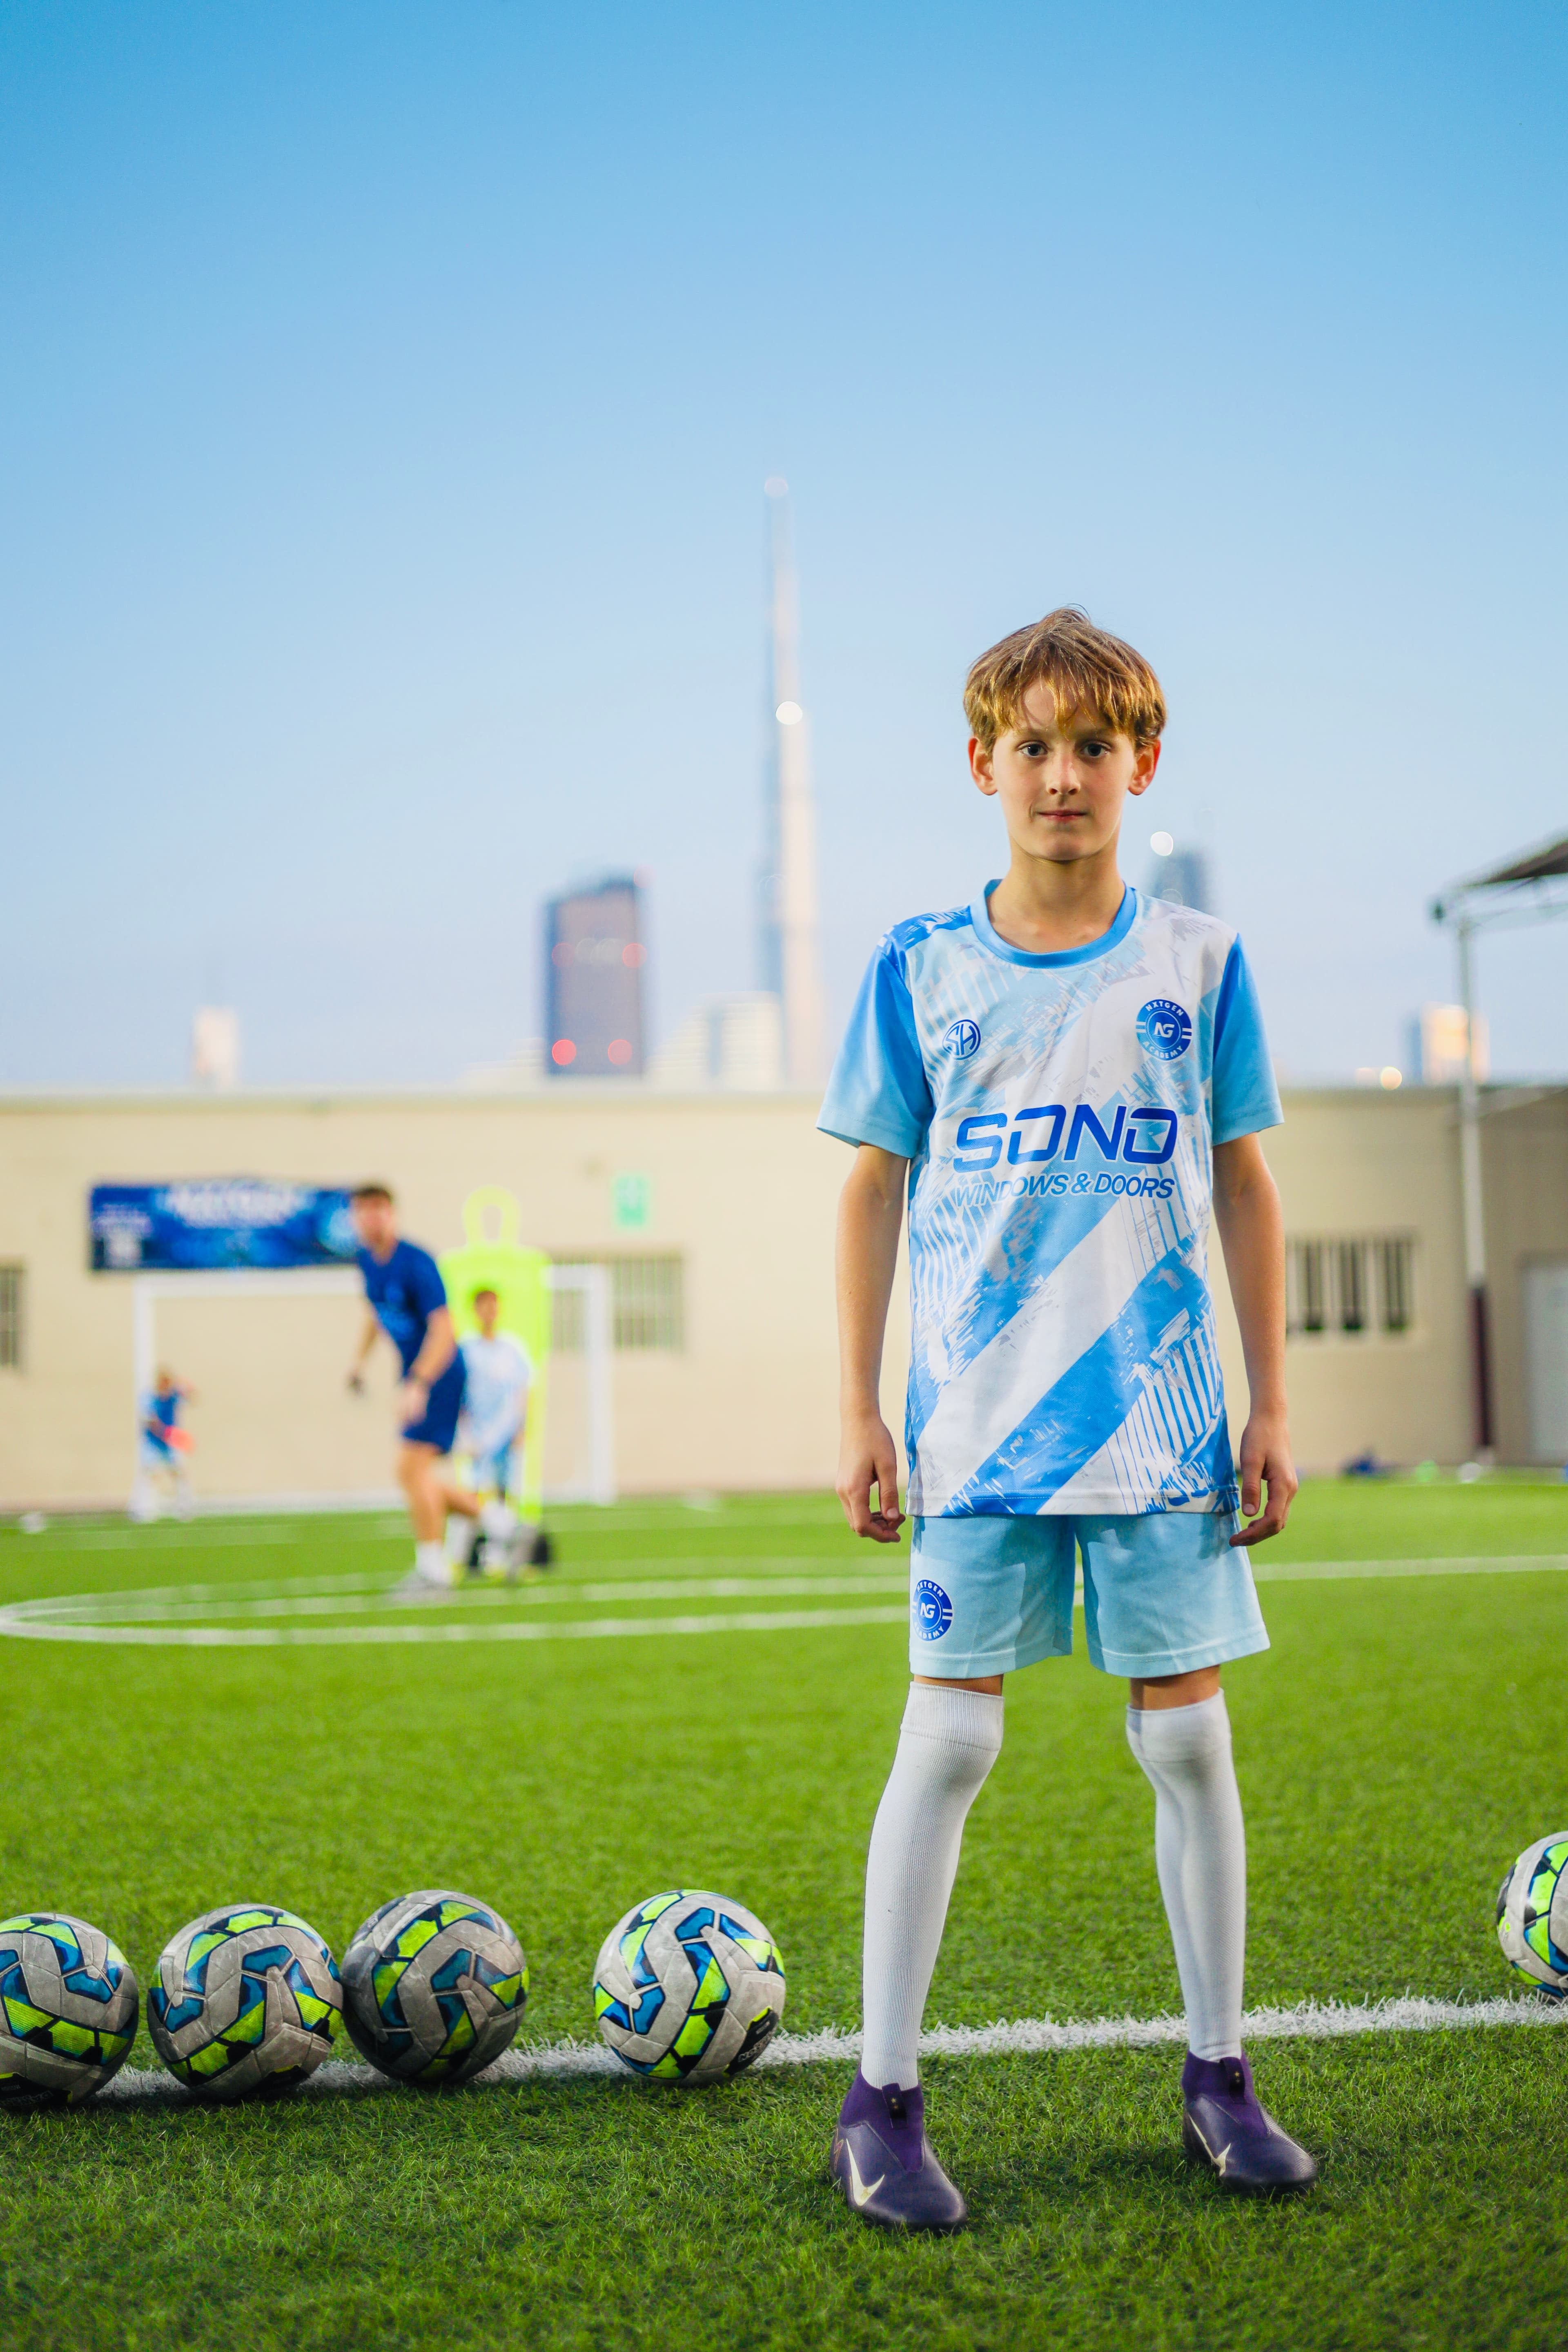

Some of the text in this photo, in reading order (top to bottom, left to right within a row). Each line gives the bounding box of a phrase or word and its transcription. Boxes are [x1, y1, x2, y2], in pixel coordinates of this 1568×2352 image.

[1145, 1001, 1184, 1016] NXTGEN
[1143, 1041, 1183, 1059] ACADEMY
[953, 1104, 1178, 1173] SONO
[956, 1173, 1175, 1207] WINDOWS & DOORS
[917, 1581, 943, 1597] NXTGEN
